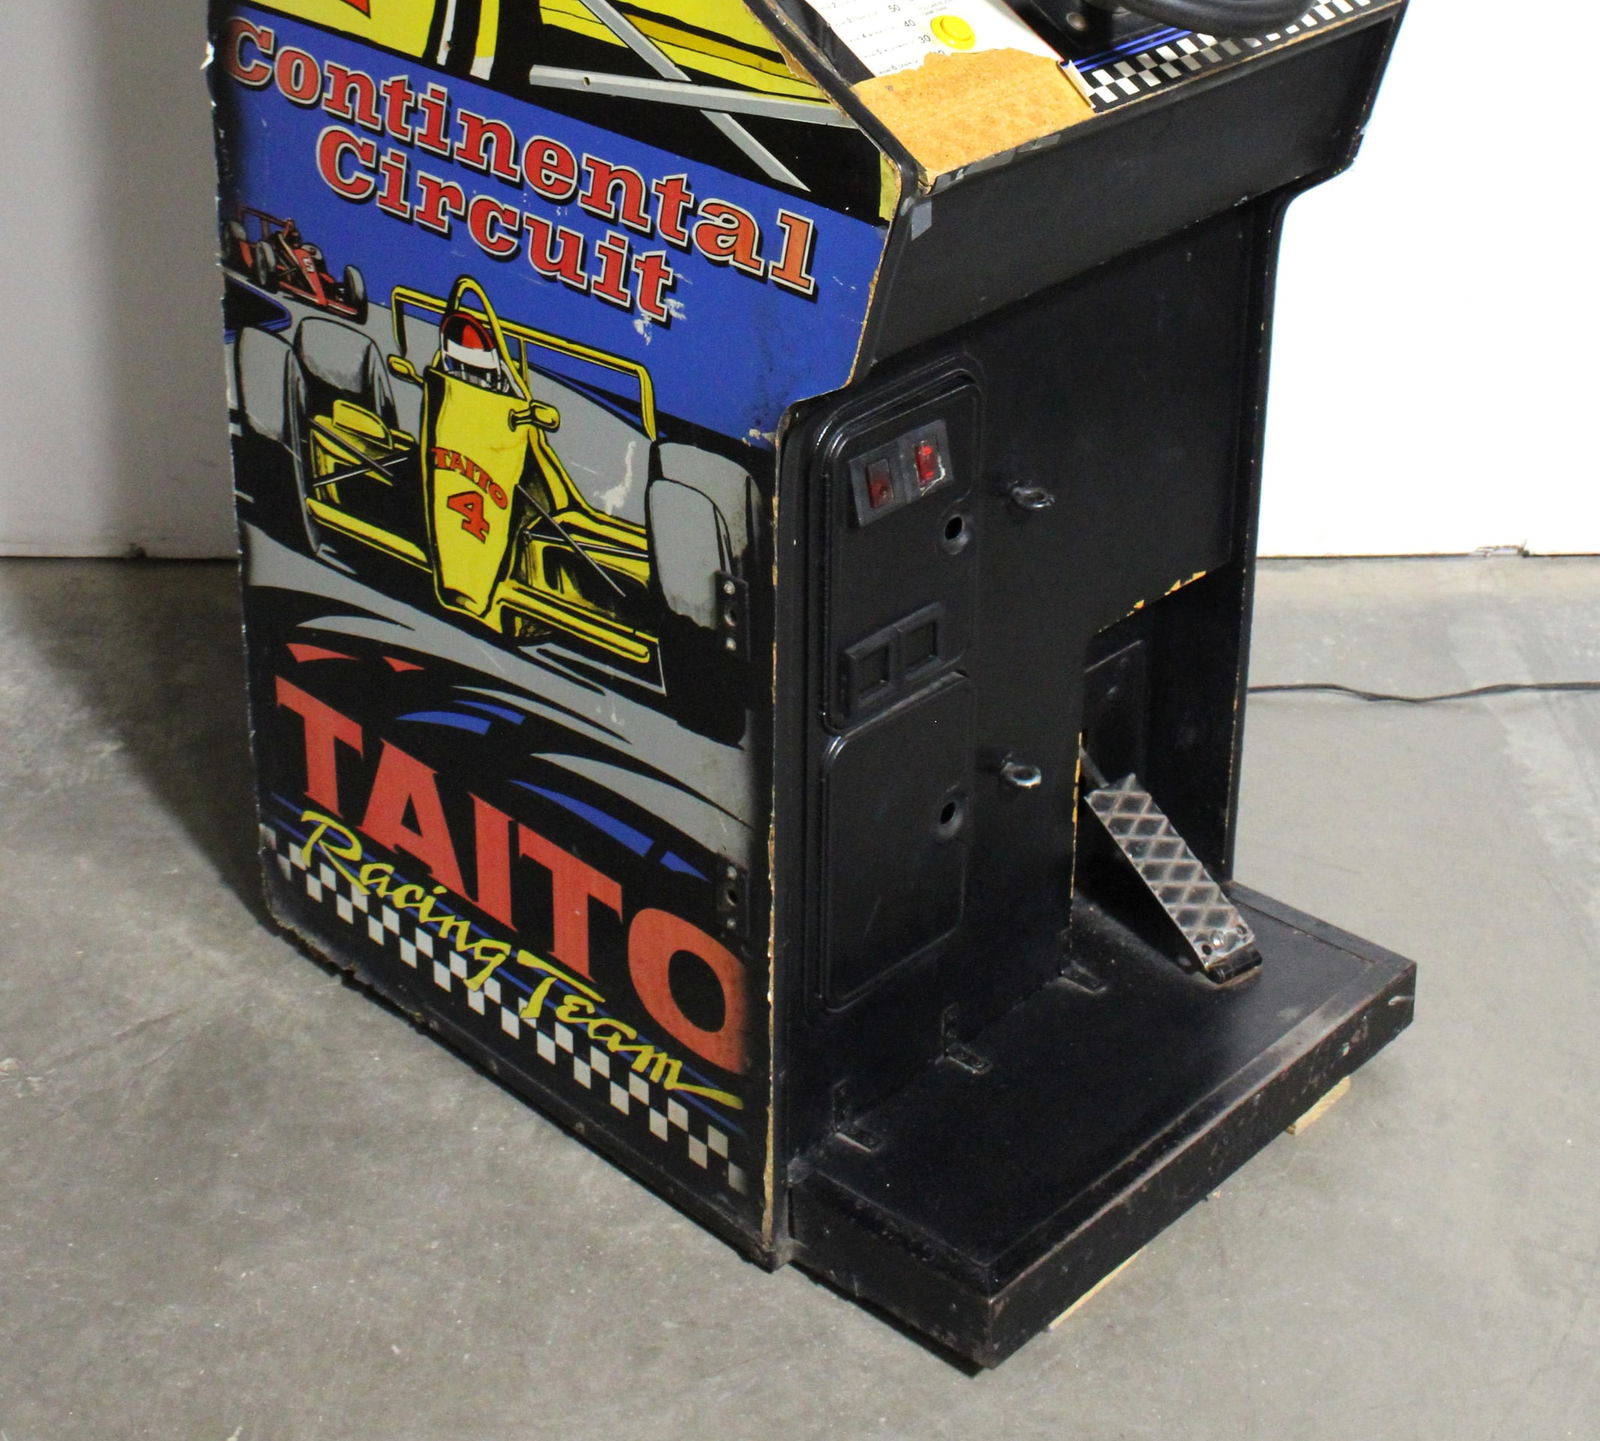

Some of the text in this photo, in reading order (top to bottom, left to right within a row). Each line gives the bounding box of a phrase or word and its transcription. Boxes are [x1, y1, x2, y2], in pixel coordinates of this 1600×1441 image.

[903, 19, 916, 28] 40
[918, 34, 931, 43] 30
[223, 16, 817, 295] Continental
[316, 125, 674, 323] Circuit
[431, 447, 508, 510] TAITO
[447, 491, 490, 544] 4
[275, 675, 748, 1075] TAITO
[300, 810, 744, 1110] Racing Team
